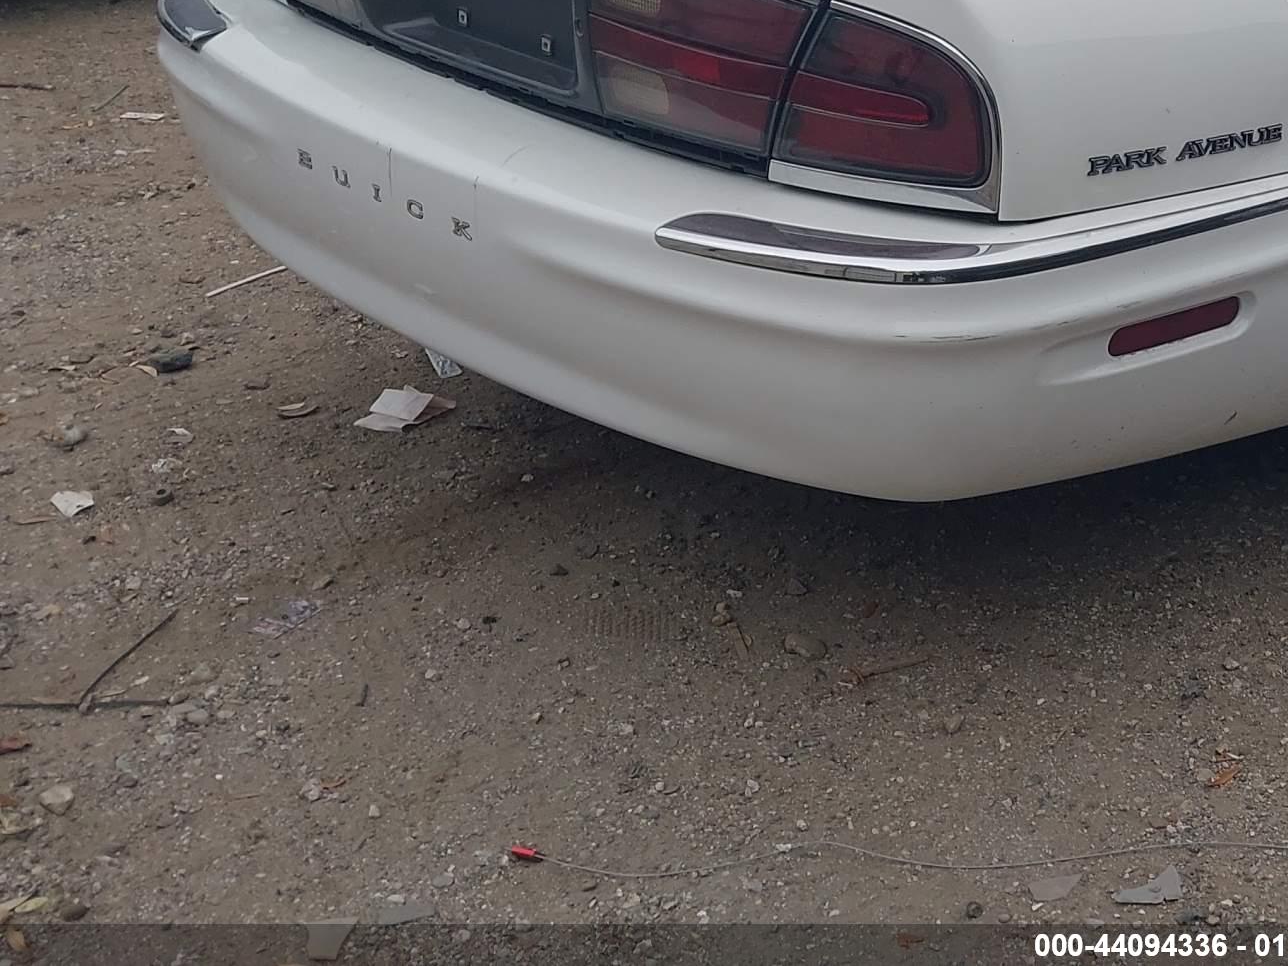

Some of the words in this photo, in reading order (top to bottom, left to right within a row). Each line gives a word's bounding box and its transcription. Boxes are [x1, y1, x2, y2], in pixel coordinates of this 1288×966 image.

[1087, 146, 1168, 177] PARK
[1175, 123, 1283, 162] AVENUE
[296, 147, 473, 242] BUICK
